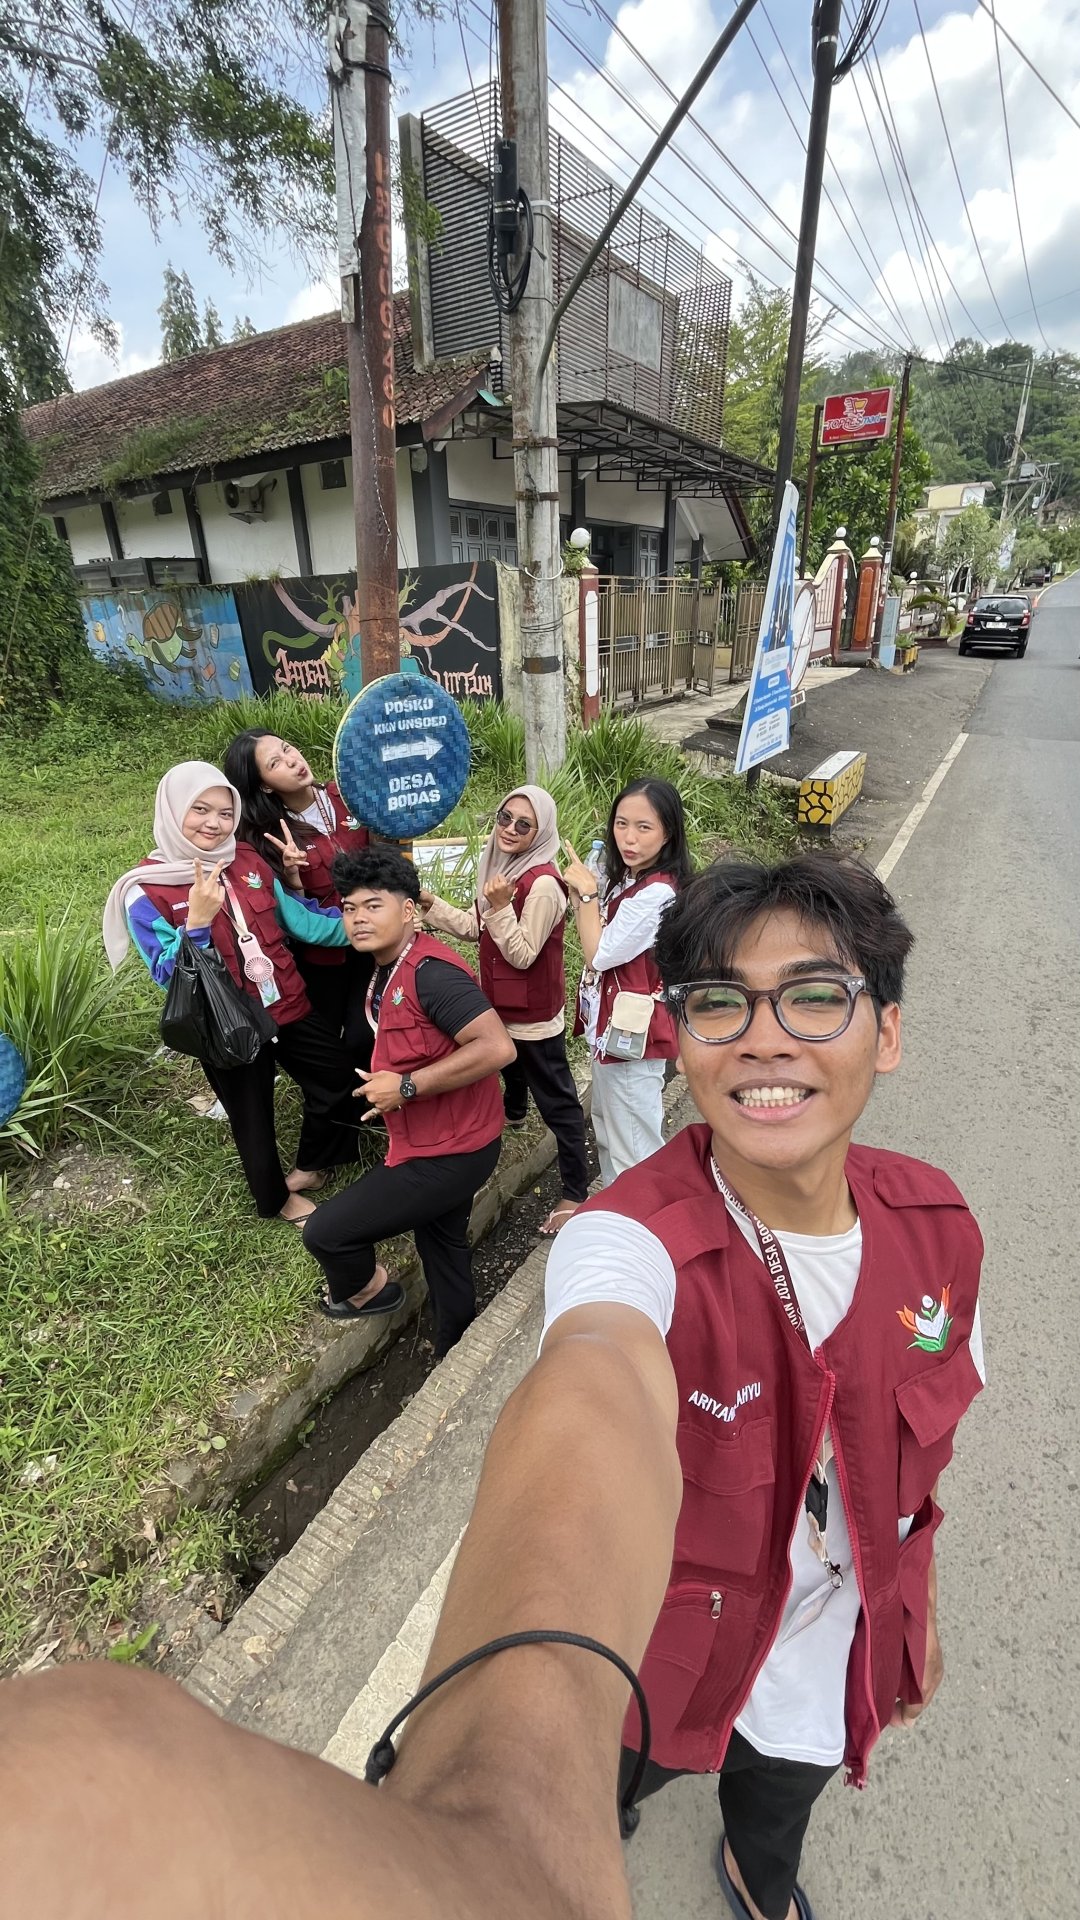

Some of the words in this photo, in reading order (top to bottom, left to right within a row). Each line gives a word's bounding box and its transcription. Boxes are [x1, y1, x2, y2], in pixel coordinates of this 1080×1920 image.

[384, 697, 434, 715] POSKO
[374, 721, 397, 736] KKN
[398, 715, 447, 731] UNSOED
[388, 772, 436, 794] DESA
[388, 789, 441, 811] BODAS
[750, 1210, 774, 1245] BOD
[764, 1243, 783, 1275] DESA
[773, 1274, 791, 1300] 2026
[734, 1382, 761, 1410] AHYU
